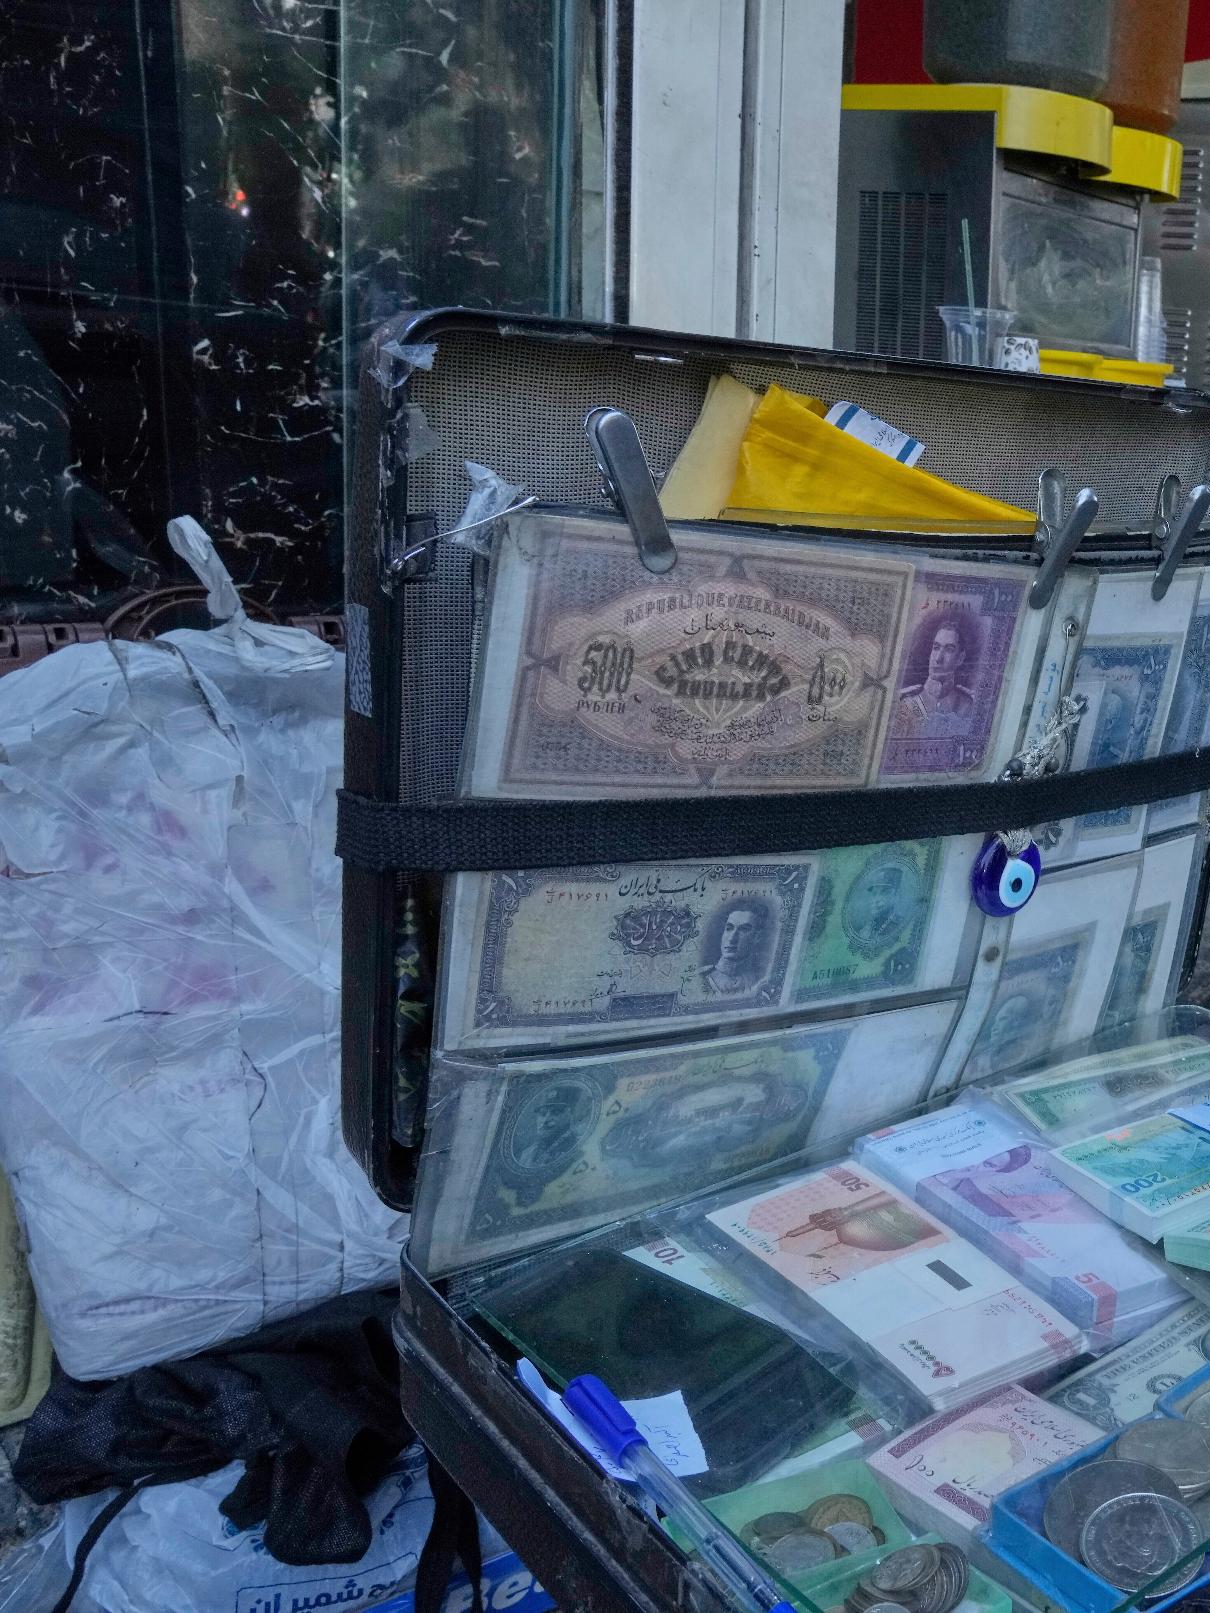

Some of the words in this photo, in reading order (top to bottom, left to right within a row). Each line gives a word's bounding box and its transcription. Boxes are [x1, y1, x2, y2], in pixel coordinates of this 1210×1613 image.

[577, 639, 635, 700] 500
[841, 1176, 870, 1193] 50
[1120, 1171, 1167, 1194] 200
[653, 1247, 685, 1266] 10
